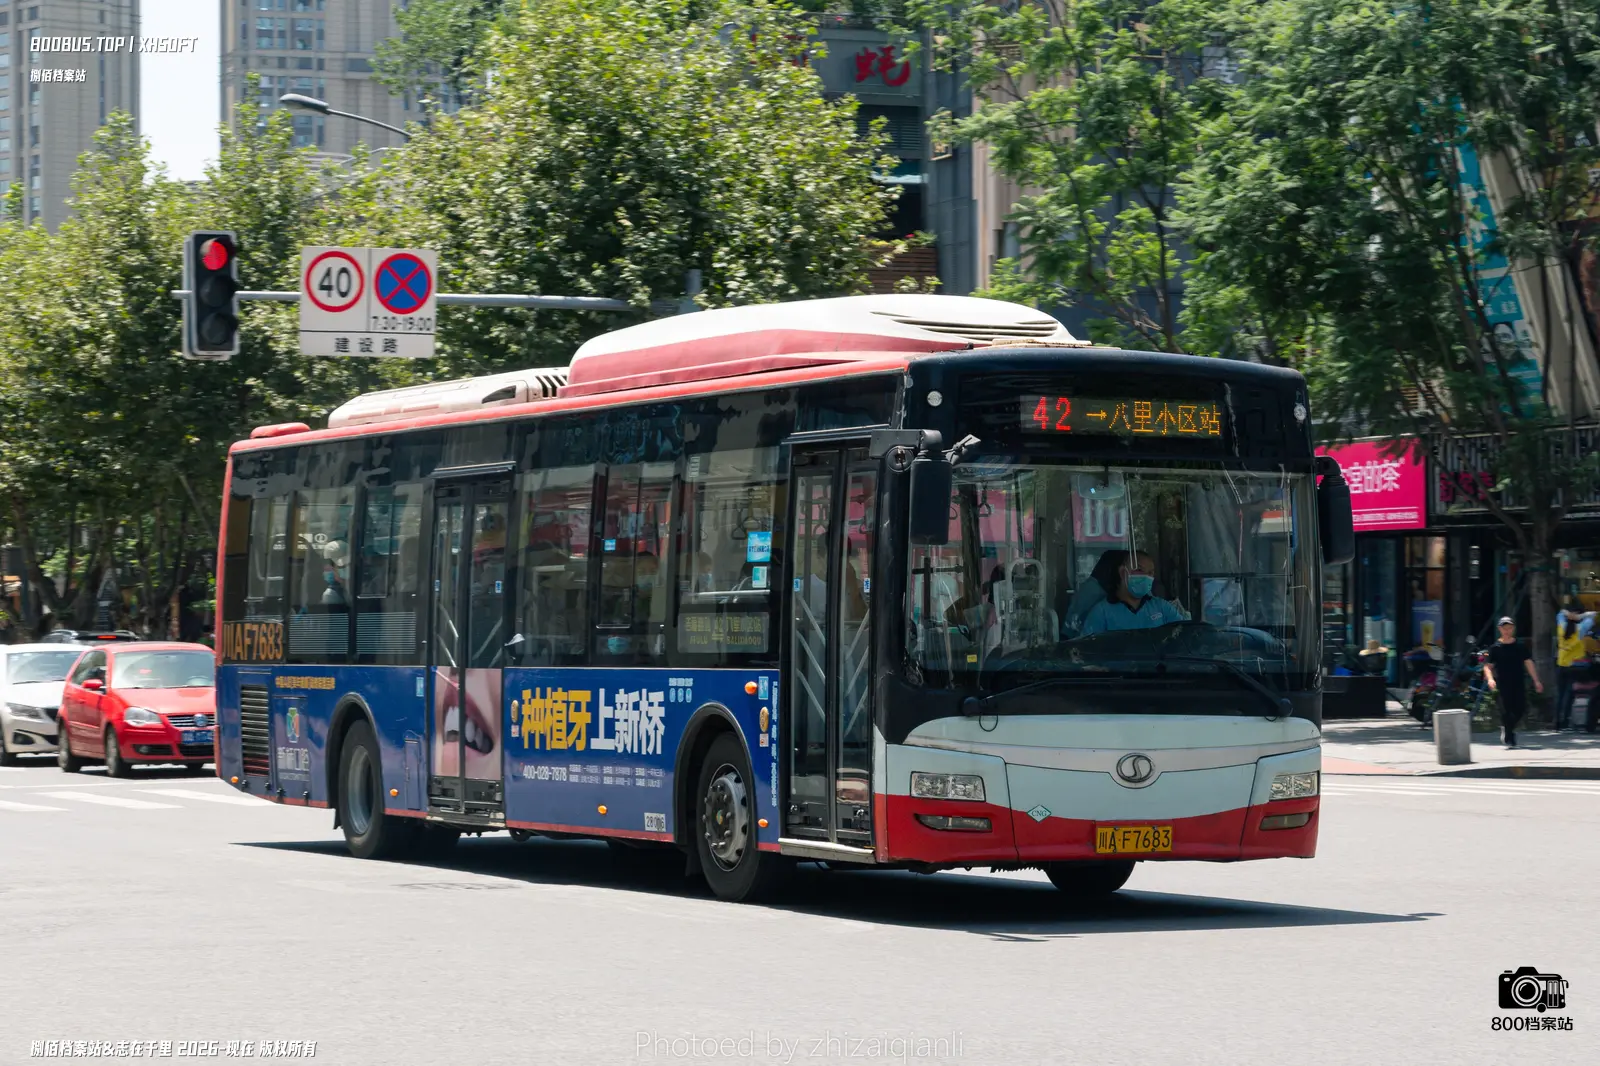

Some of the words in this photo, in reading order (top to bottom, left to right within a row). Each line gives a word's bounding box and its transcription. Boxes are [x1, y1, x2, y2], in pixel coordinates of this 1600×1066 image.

[318, 266, 352, 298] 40
[334, 337, 398, 353] 建设路
[1033, 396, 1071, 430] 42
[1108, 400, 1222, 436] 八里小区站
